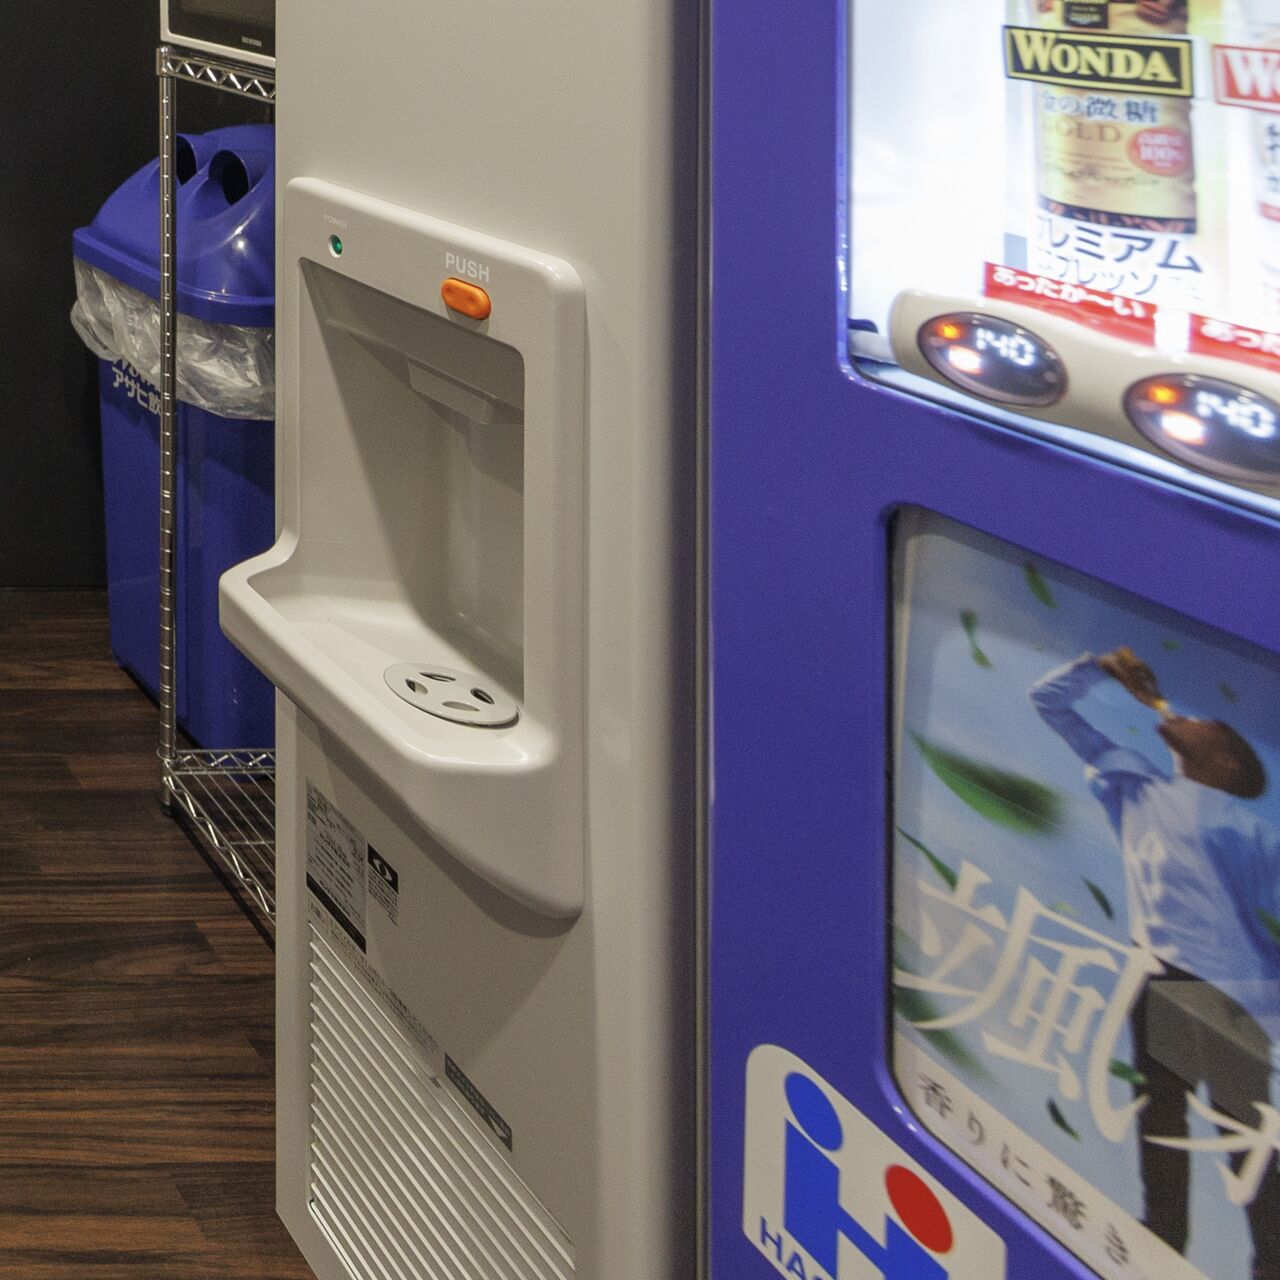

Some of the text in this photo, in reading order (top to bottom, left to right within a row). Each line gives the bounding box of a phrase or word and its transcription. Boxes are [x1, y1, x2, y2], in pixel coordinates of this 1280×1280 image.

[1010, 28, 1178, 84] WONDA
[444, 250, 491, 284] PUSH
[975, 326, 1037, 368] 140
[1195, 389, 1277, 439] 140
